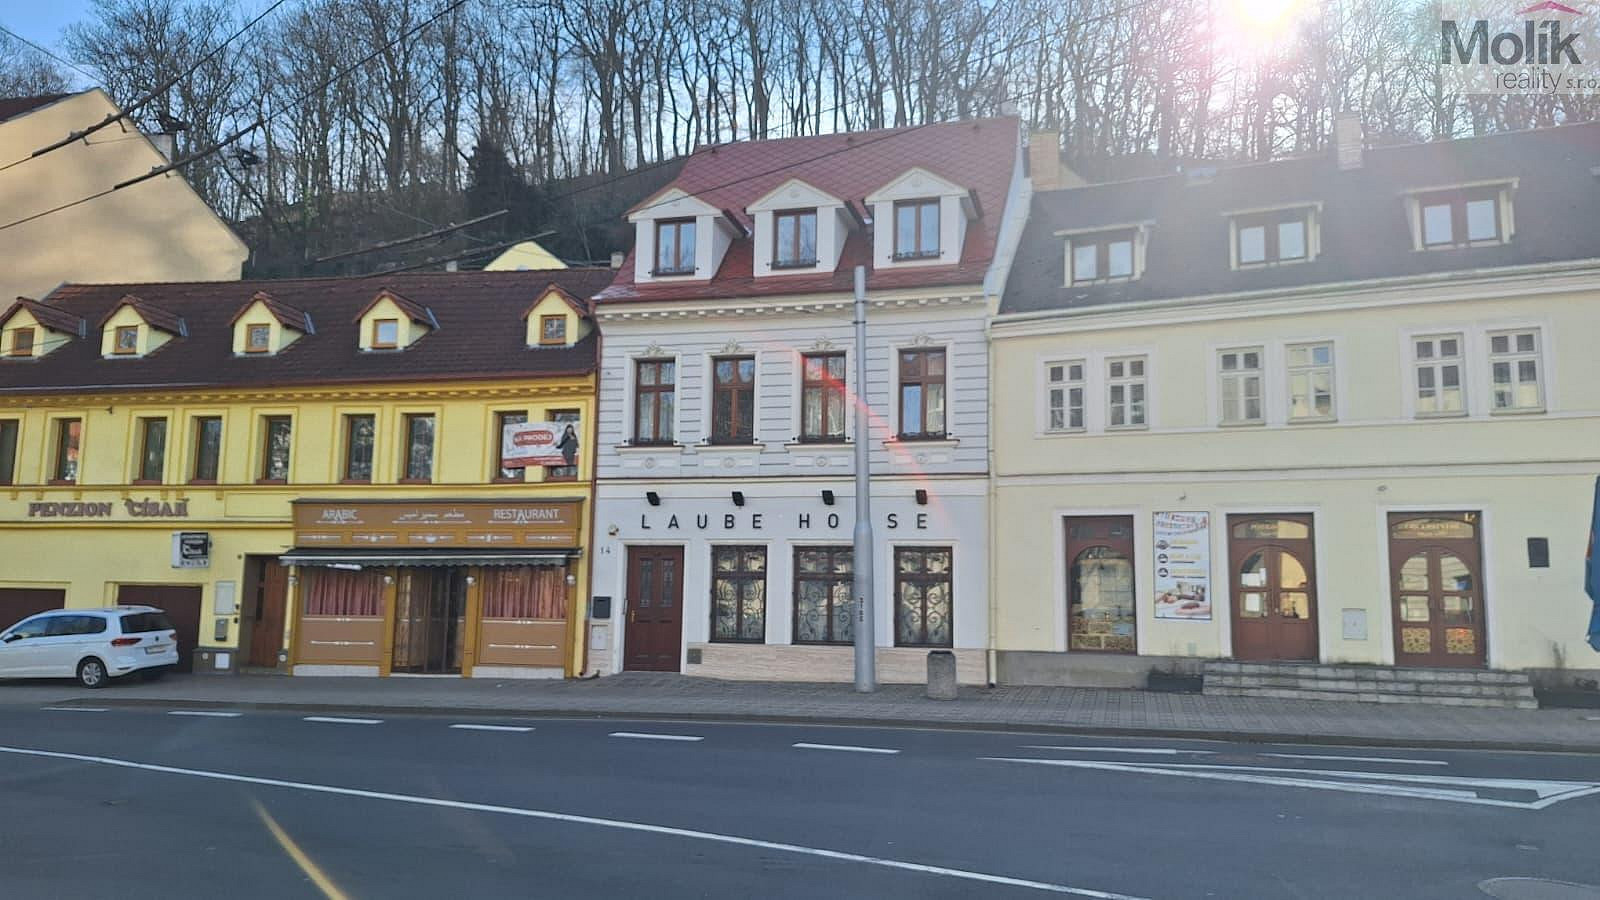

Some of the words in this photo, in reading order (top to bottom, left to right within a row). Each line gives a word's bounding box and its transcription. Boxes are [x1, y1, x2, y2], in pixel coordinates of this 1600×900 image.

[28, 502, 113, 517] PENZION
[322, 509, 358, 521] ARABIC
[493, 508, 561, 522] RESTAURANT
[641, 514, 762, 529] LAUBE
[799, 513, 928, 529] HOSE
[601, 547, 611, 555] 14
